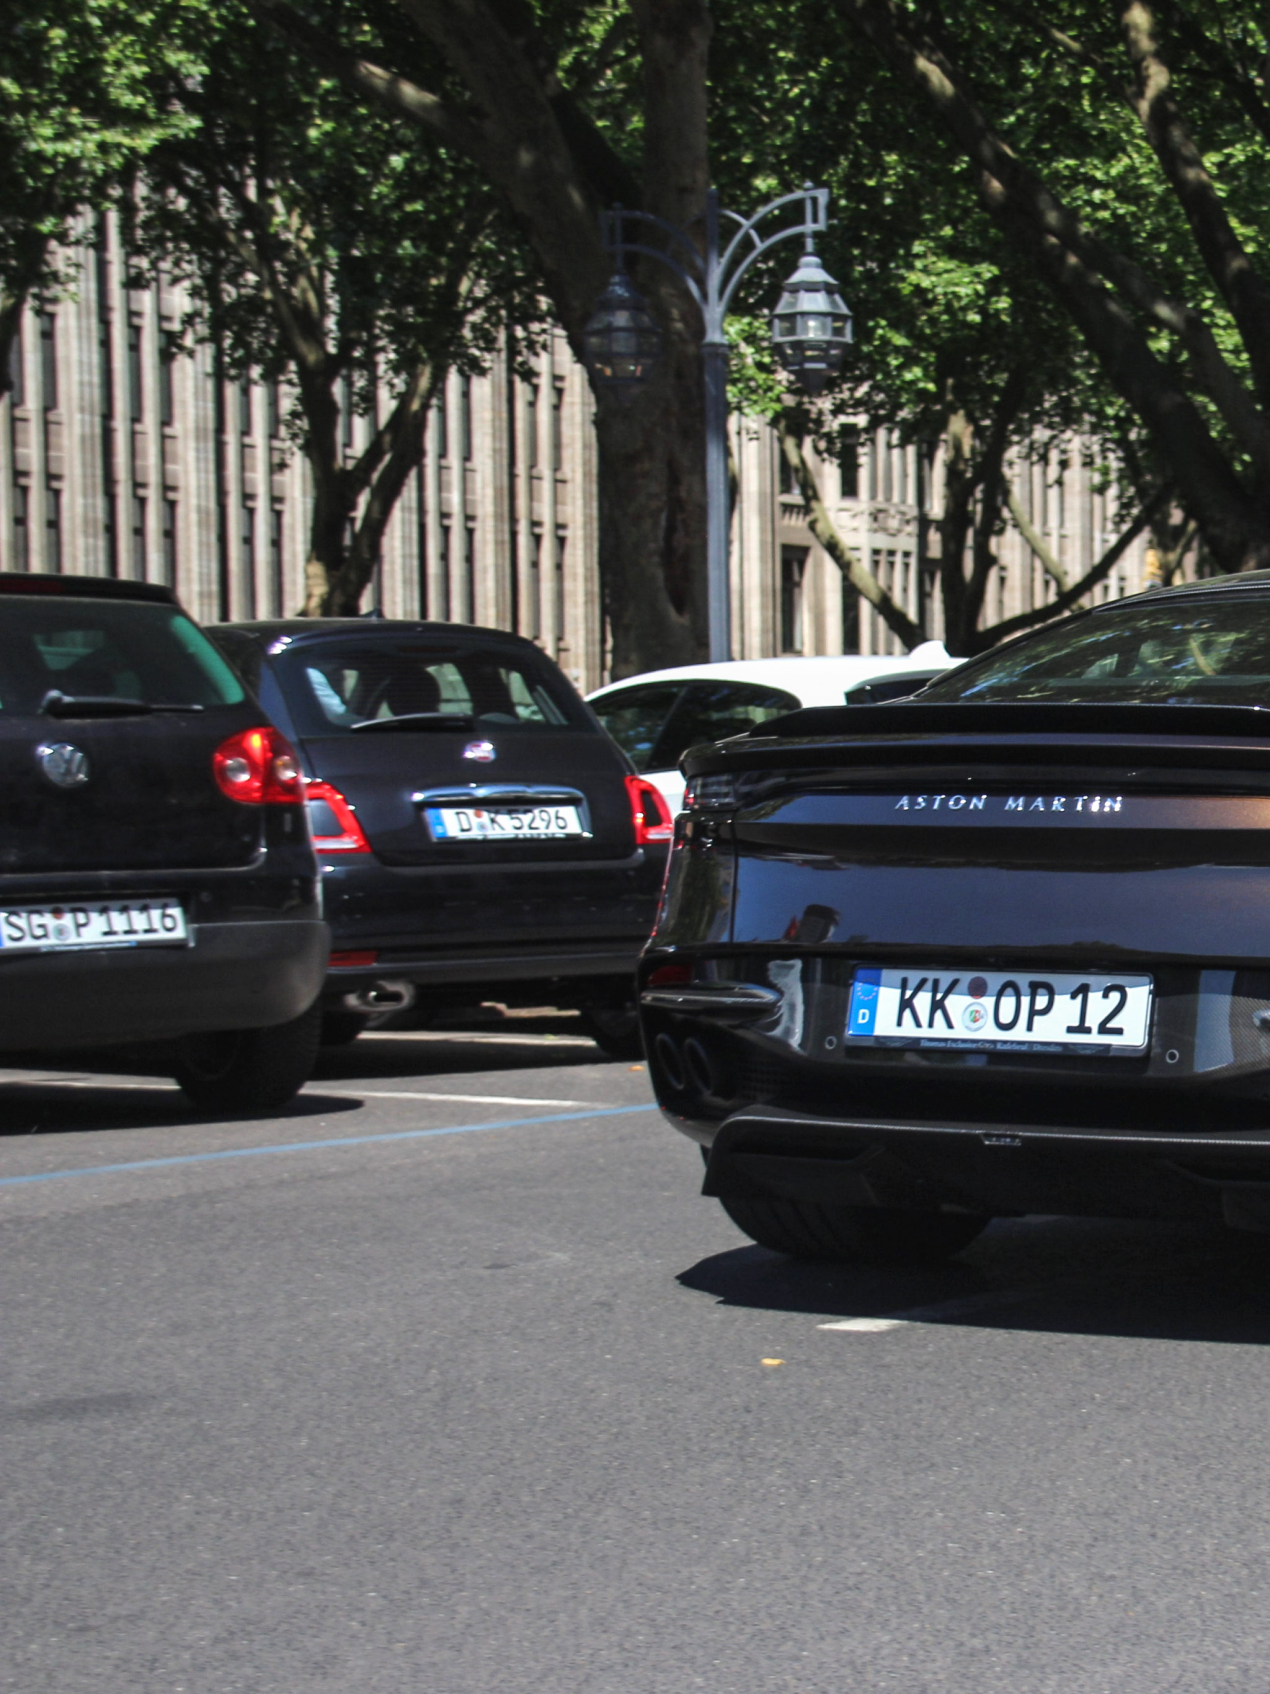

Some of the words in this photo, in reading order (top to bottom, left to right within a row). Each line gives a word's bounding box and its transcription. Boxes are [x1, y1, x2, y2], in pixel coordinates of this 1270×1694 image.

[895, 795, 986, 810] ASTON
[1004, 796, 1122, 812] MARTIN
[455, 811, 472, 832] D
[511, 809, 567, 830] 5296
[5, 909, 49, 942] SG
[70, 906, 91, 937] P
[100, 902, 177, 937] 1116
[858, 1008, 870, 1024] D
[896, 976, 960, 1029] KK
[993, 980, 1055, 1032] OP
[1066, 982, 1128, 1035] 12
